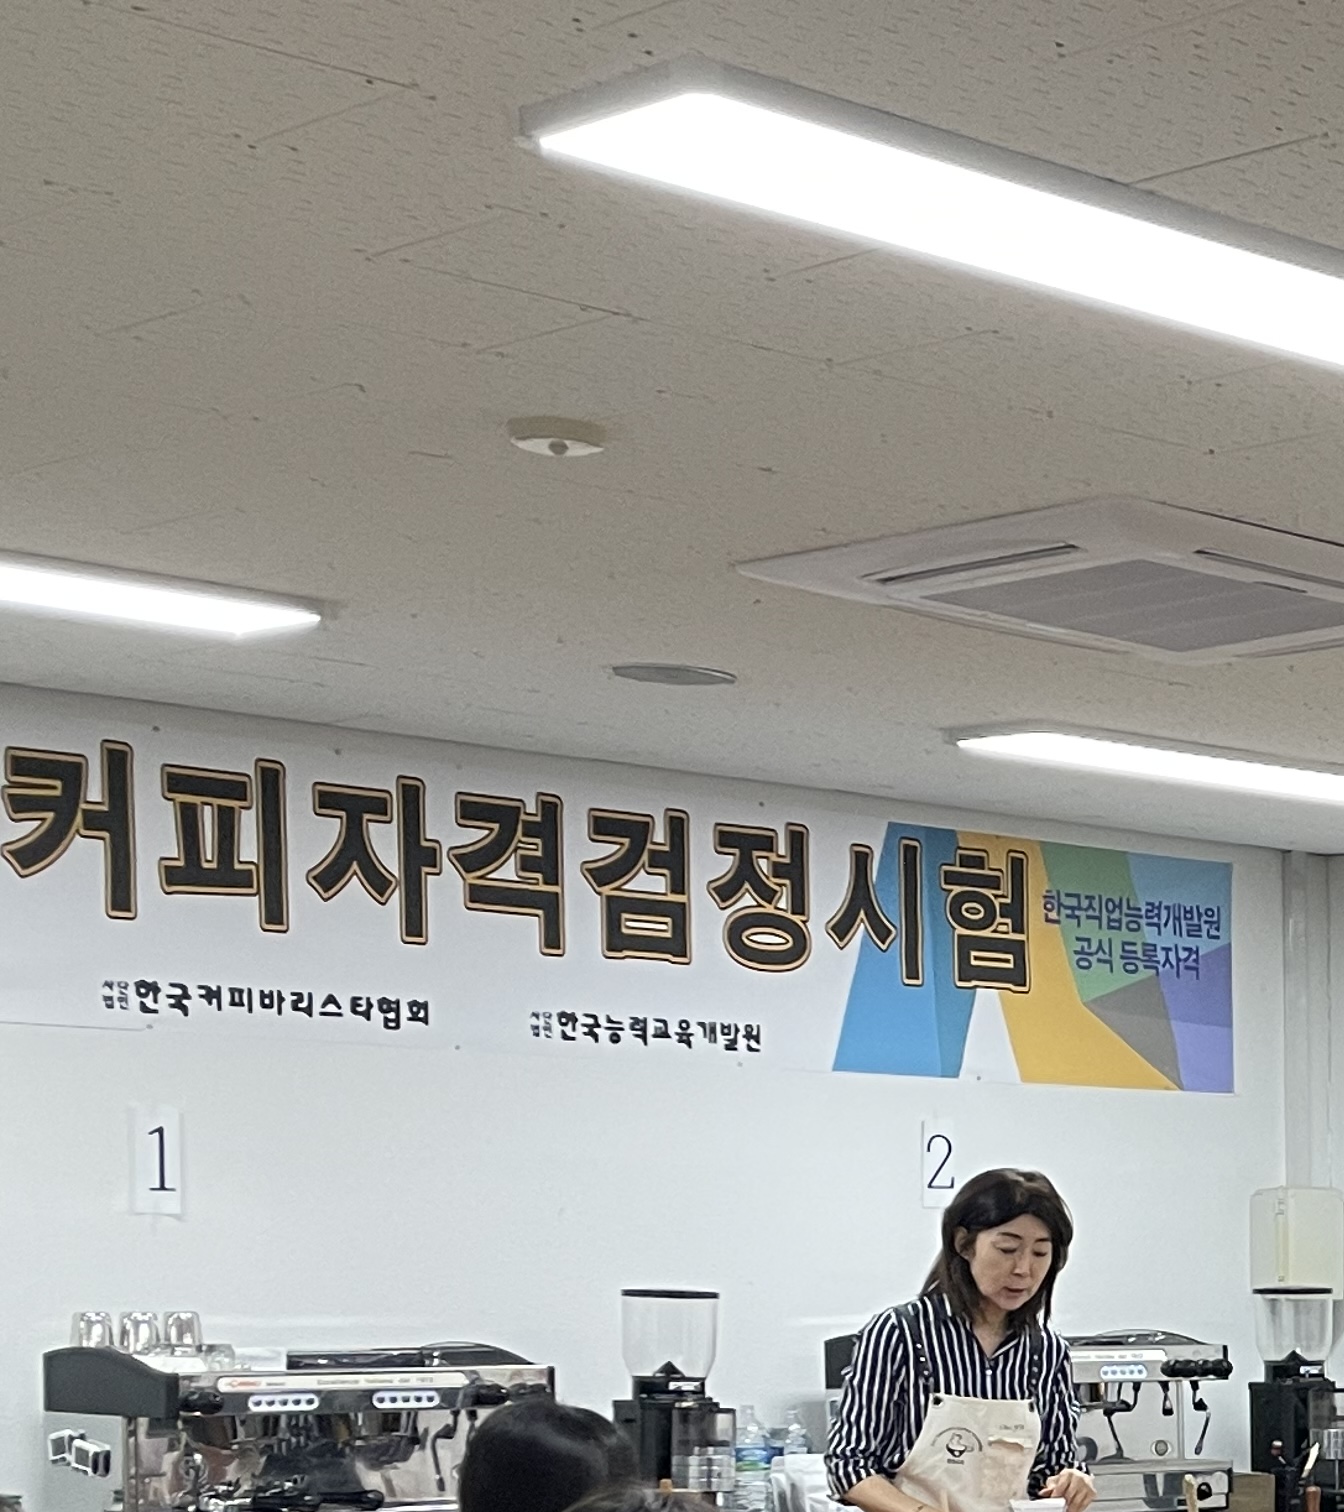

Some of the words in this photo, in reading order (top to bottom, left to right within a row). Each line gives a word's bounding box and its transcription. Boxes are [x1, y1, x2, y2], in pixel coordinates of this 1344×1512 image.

[1042, 889, 1221, 941] 한국직업능력개발원
[1073, 935, 1114, 974] 공식
[1119, 940, 1201, 981] 등록자격
[133, 979, 430, 1031] 한국커피바리스타협회
[557, 1010, 761, 1053] 한국능력교육개발원
[147, 1125, 177, 1192] 1
[926, 1133, 955, 1189] 2
